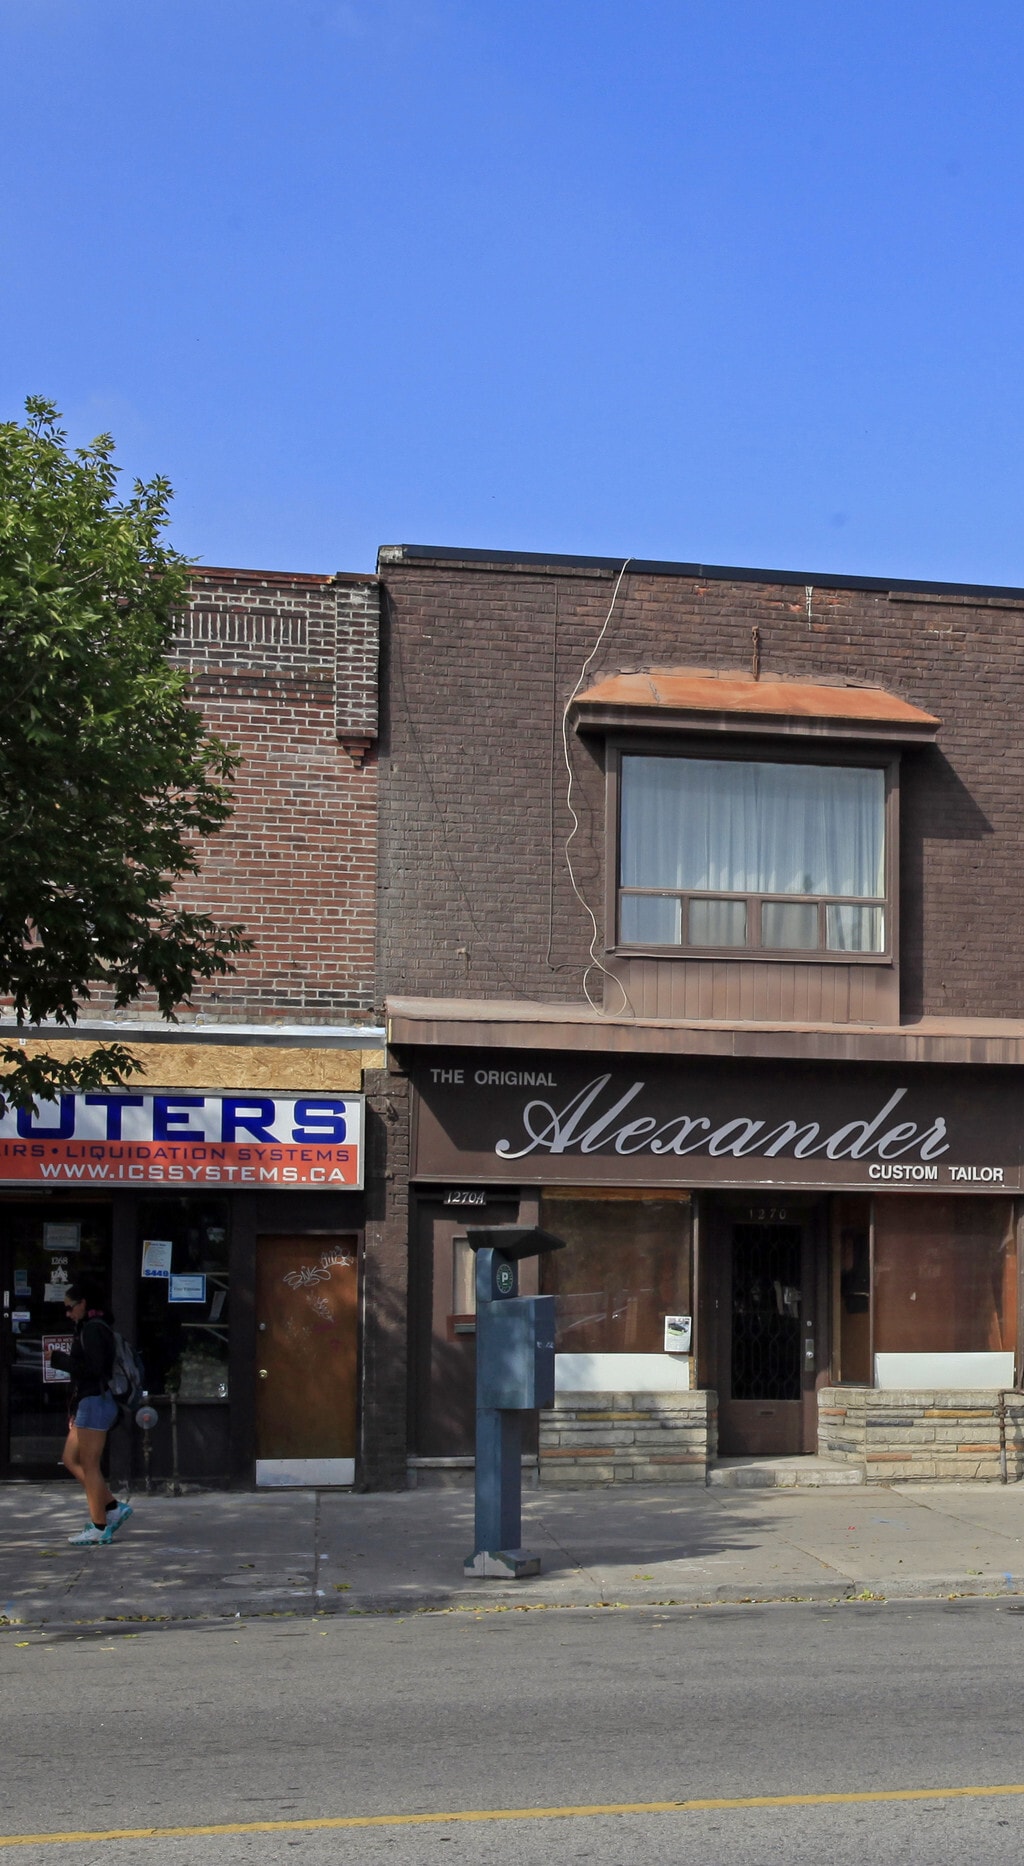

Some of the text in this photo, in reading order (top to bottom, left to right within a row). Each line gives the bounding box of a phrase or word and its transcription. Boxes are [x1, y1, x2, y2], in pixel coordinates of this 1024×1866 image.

[430, 1069, 558, 1087] THE ORIGINAL
[0, 1093, 347, 1144] UTERS
[495, 1073, 950, 1161] Alexander
[0, 1144, 350, 1162] IRS LIQUIDATION SYSTEMS
[40, 1163, 346, 1182] WWW.ICSSYSTEMS.CA
[868, 1164, 1004, 1182] CUSTOM TAILOR
[447, 1191, 486, 1204] 1270A
[749, 1207, 787, 1220] 1270
